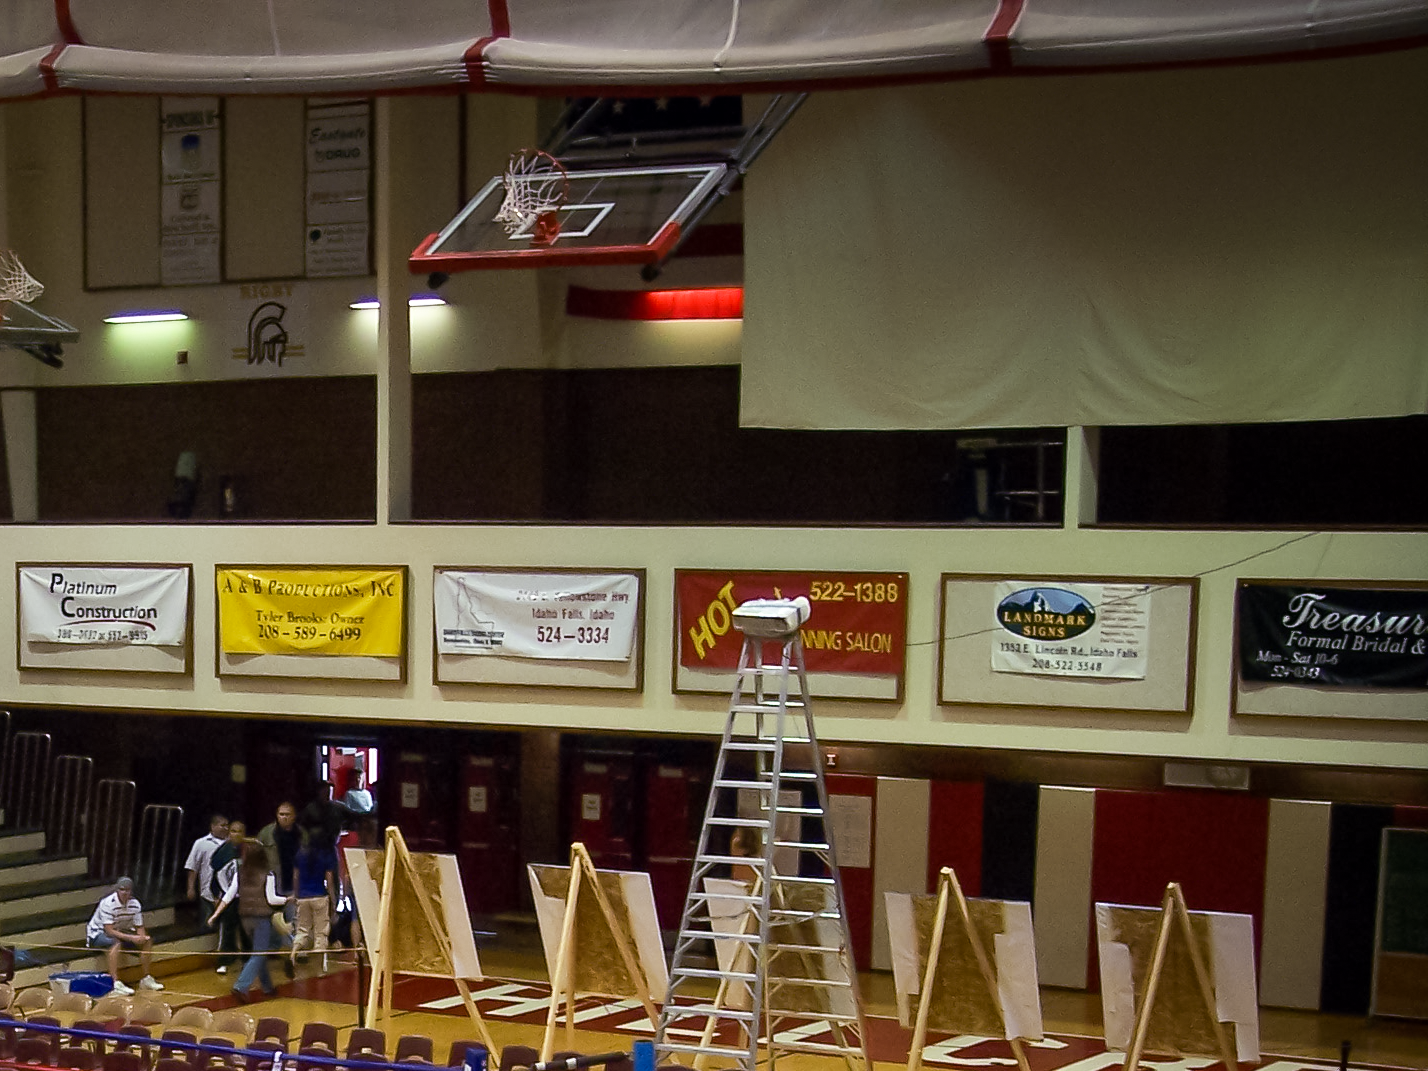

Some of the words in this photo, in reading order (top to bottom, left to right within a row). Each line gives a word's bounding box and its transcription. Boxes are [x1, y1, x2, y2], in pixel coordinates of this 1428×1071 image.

[50, 573, 117, 594] Platinum
[222, 578, 233, 594] A
[238, 581, 248, 594] &
[252, 579, 262, 594] B
[809, 581, 899, 603] 522-1388
[61, 597, 157, 619] Construction
[532, 608, 558, 620] Idaho
[590, 608, 615, 620] Idaho
[1004, 611, 1087, 626] LANDMARK
[1282, 593, 1428, 635] Treasur
[688, 580, 738, 660] HOT
[537, 626, 610, 644] 524-3334
[846, 631, 892, 654] SALON
[1023, 626, 1067, 638] SIGNS
[1286, 630, 1349, 651] Formal
[1351, 634, 1408, 653] Bridal
[1411, 638, 1426, 655] &
